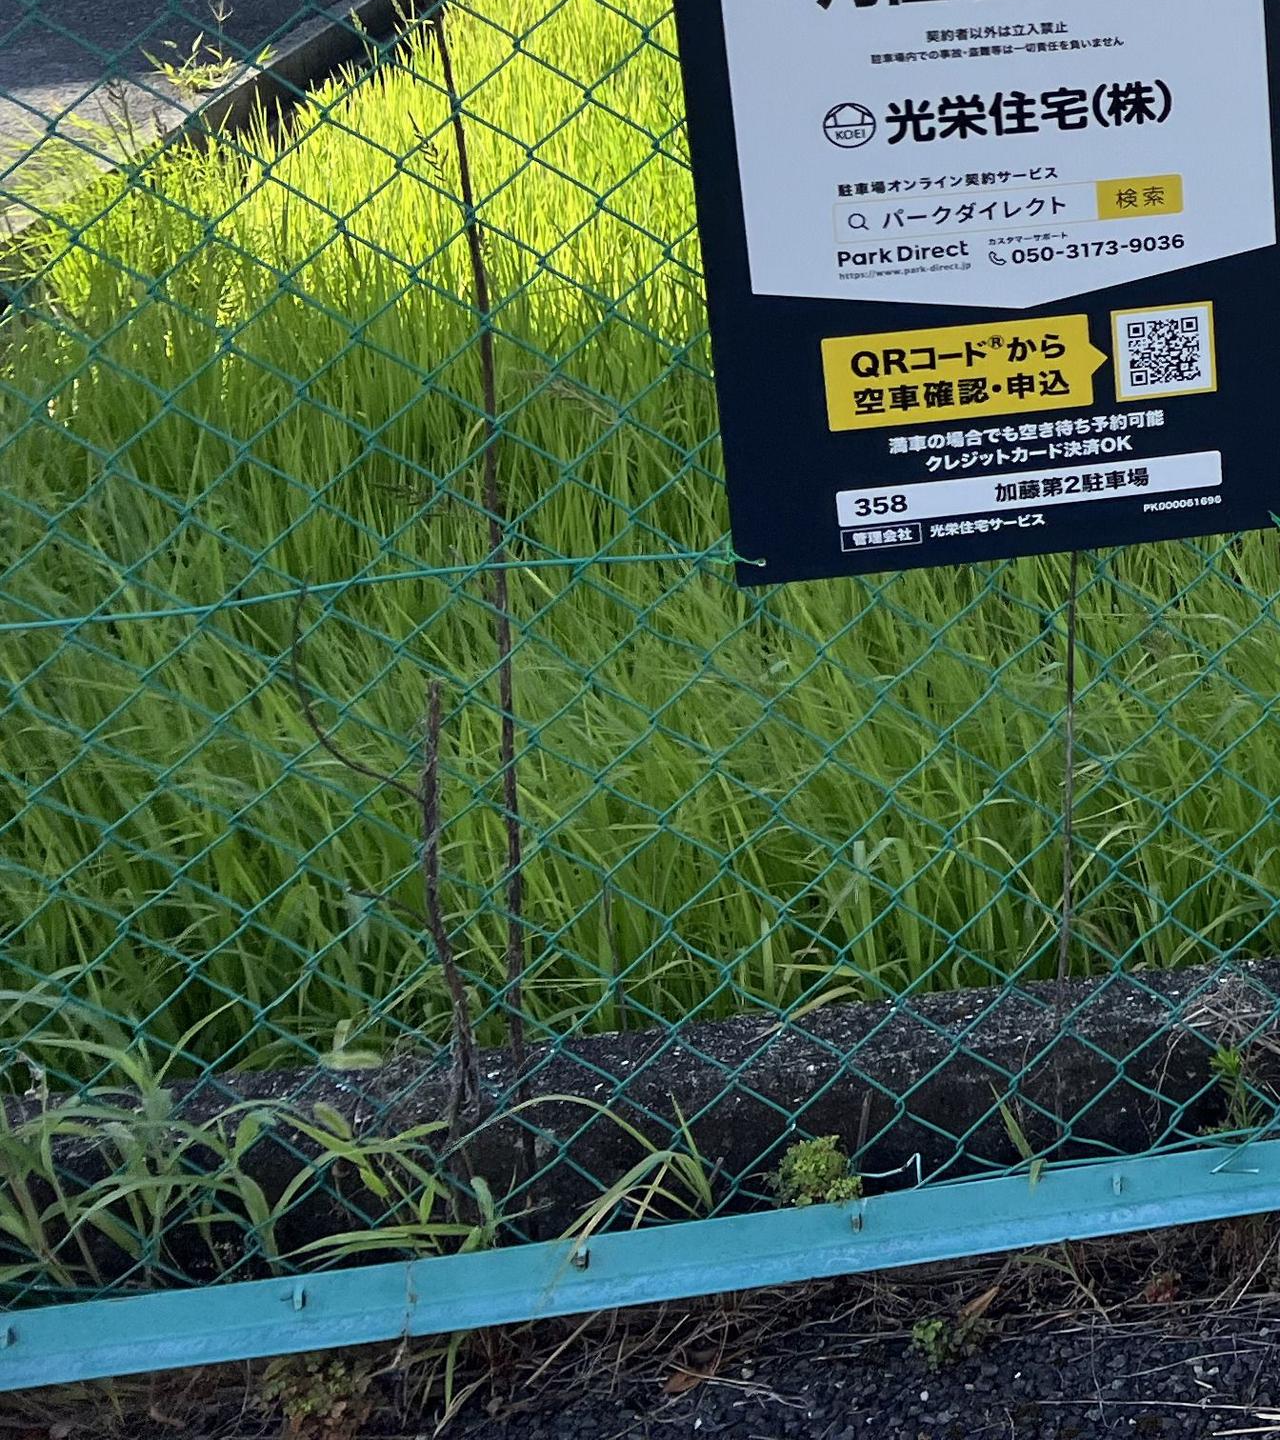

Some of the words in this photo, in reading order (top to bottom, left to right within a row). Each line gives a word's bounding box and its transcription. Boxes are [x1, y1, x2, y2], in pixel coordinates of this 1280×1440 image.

[926, 21, 1068, 43] 契約者以外は立入禁止
[885, 79, 1173, 144] 光栄住宅(株)
[834, 127, 866, 141] KOEI
[838, 167, 1059, 197] 駐車場オンライン契約サービス
[1115, 186, 1165, 209] 検索
[883, 195, 1067, 229] パークダイレクト
[838, 244, 891, 267] Park
[896, 240, 969, 261] Direct
[988, 232, 1068, 246] カスタマーサポート
[1012, 234, 1185, 265] 050-3173-9036
[838, 262, 972, 281] https://www.park-direct.jp
[853, 371, 1070, 415] 空車確認・申込
[889, 409, 1165, 454] 満車の場合でも空き待ち予約可能
[925, 435, 1133, 472] クレジットカード決済OK
[854, 494, 908, 517] 358
[995, 467, 1149, 503] 加藤第2駐車場
[852, 528, 913, 547] 管理会社
[929, 513, 1046, 539] 光栄住宅サービス
